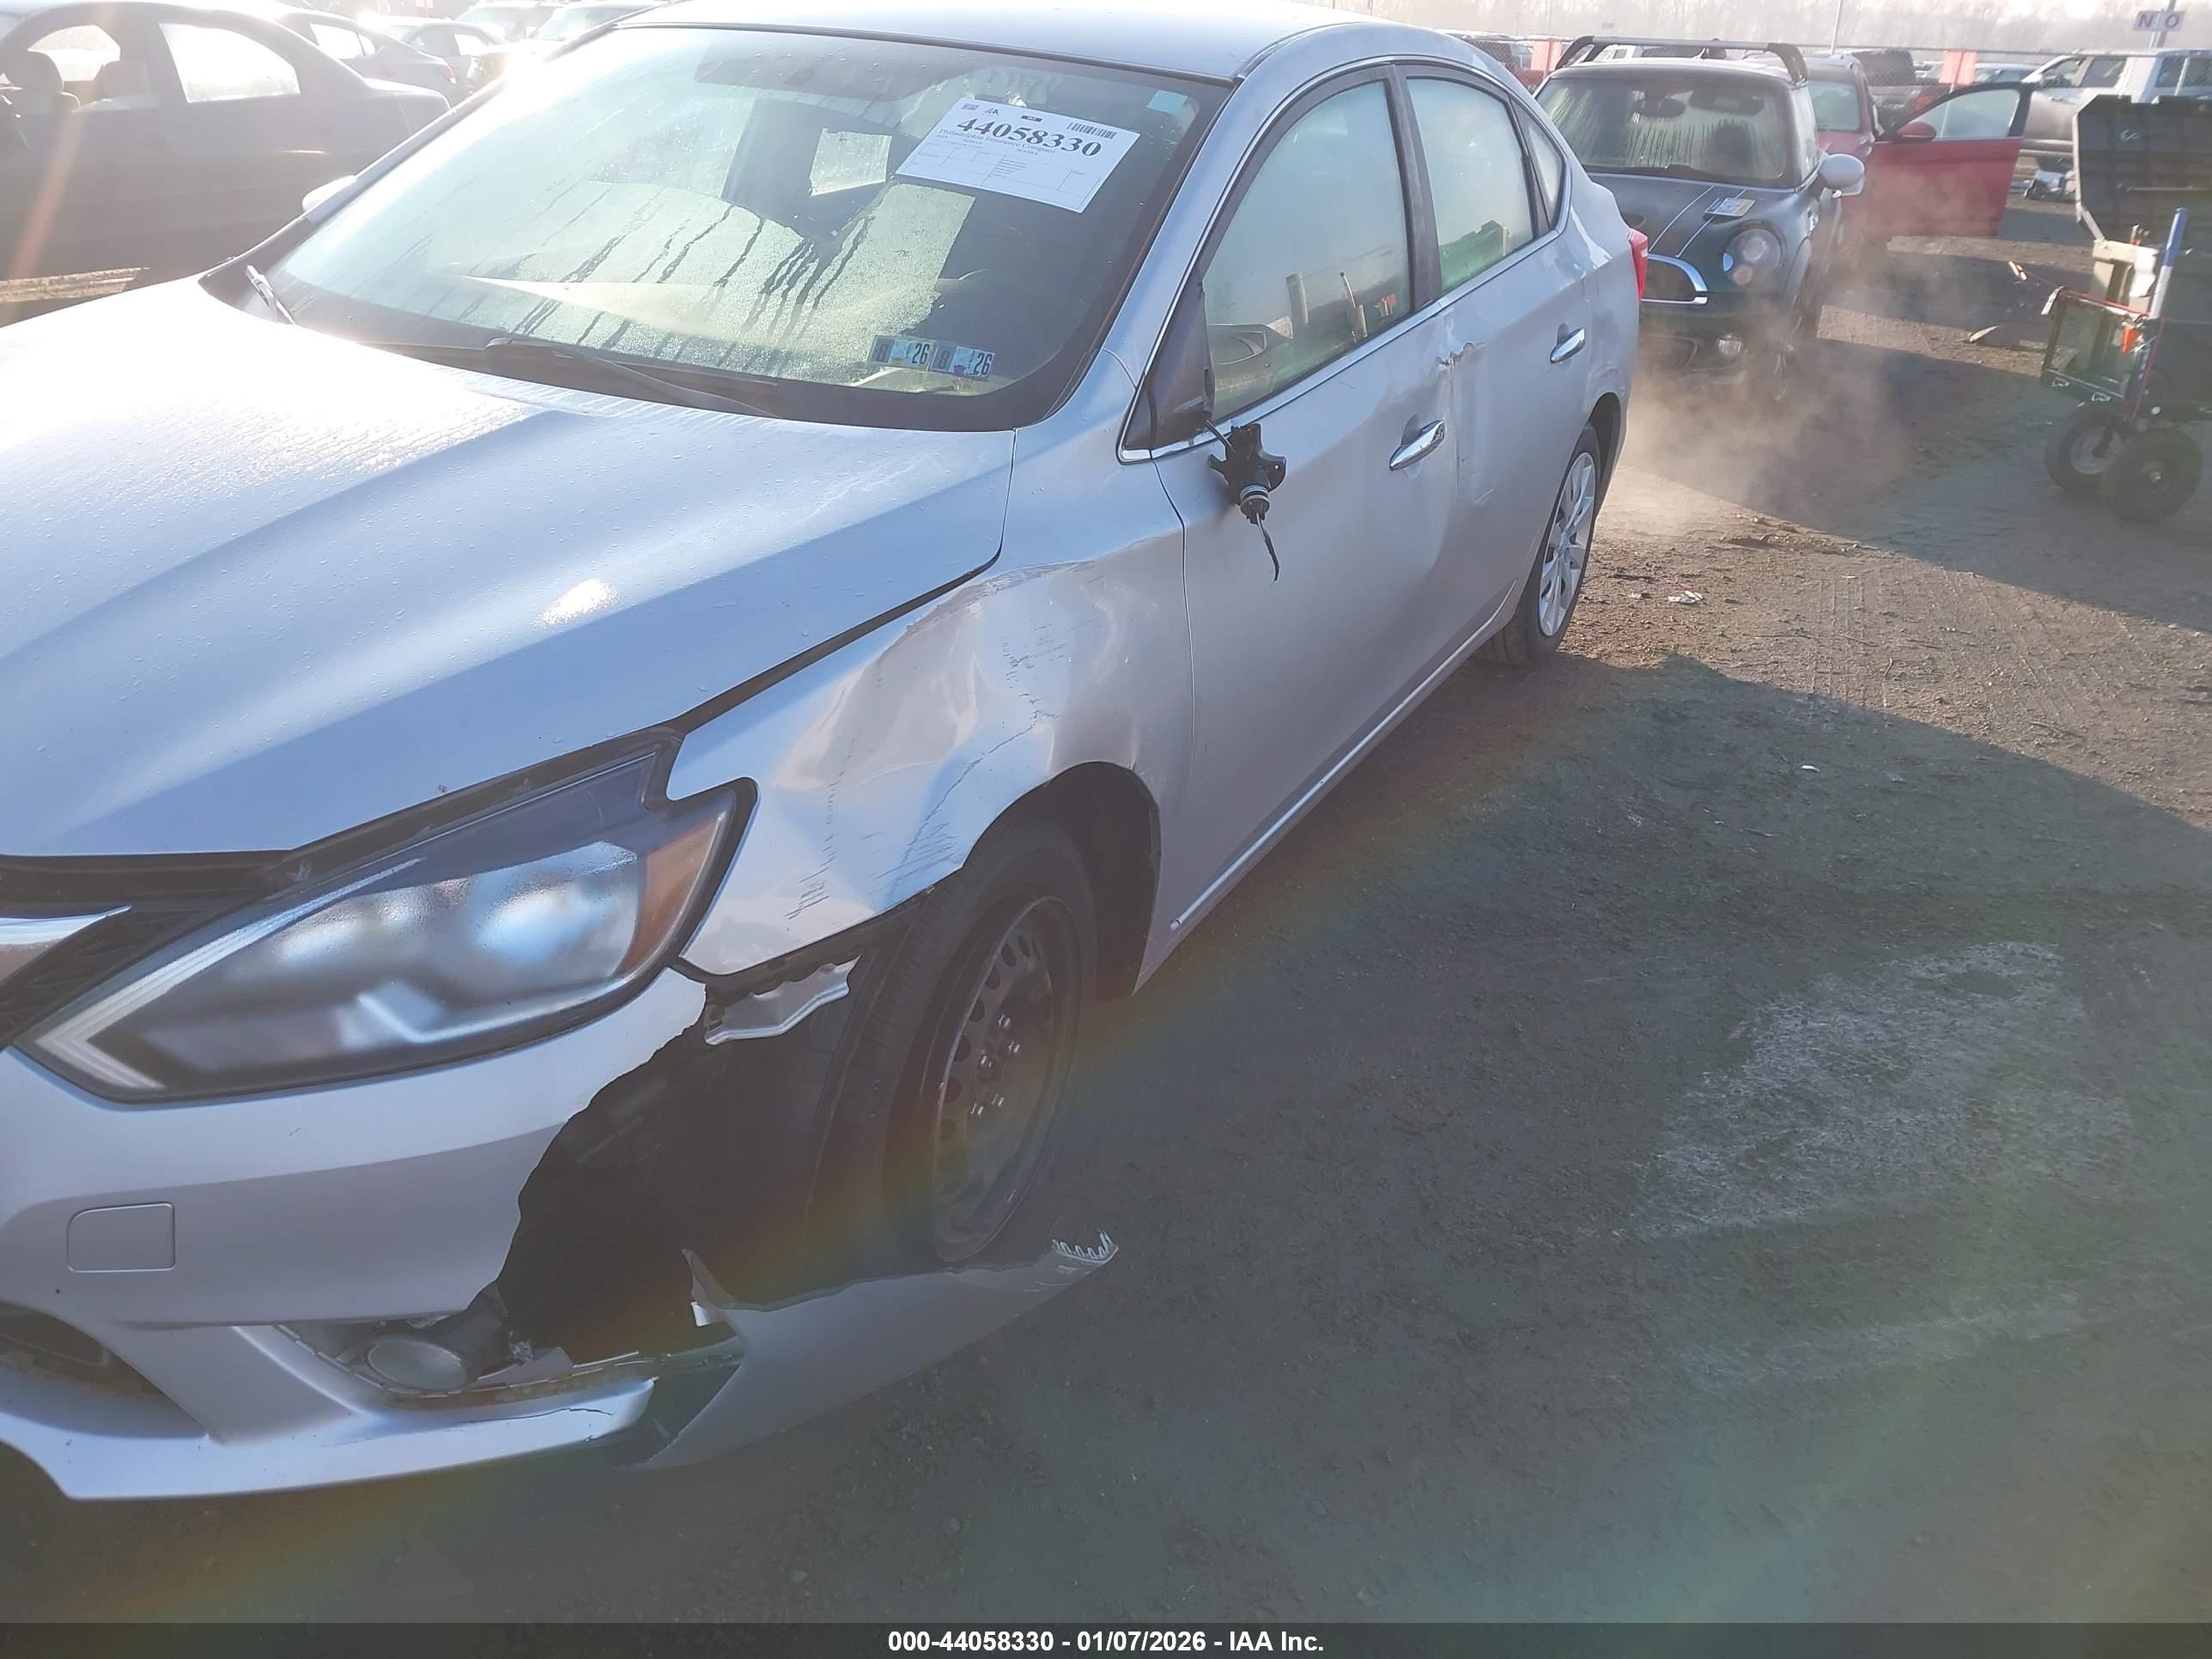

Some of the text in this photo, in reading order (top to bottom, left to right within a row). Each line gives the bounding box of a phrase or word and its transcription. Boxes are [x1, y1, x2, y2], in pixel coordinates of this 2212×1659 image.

[939, 129, 983, 140] Philadelphia
[985, 137, 1021, 147] Insurance
[957, 118, 1102, 156] 44058330
[912, 343, 930, 364] 26
[973, 352, 994, 375] 26
